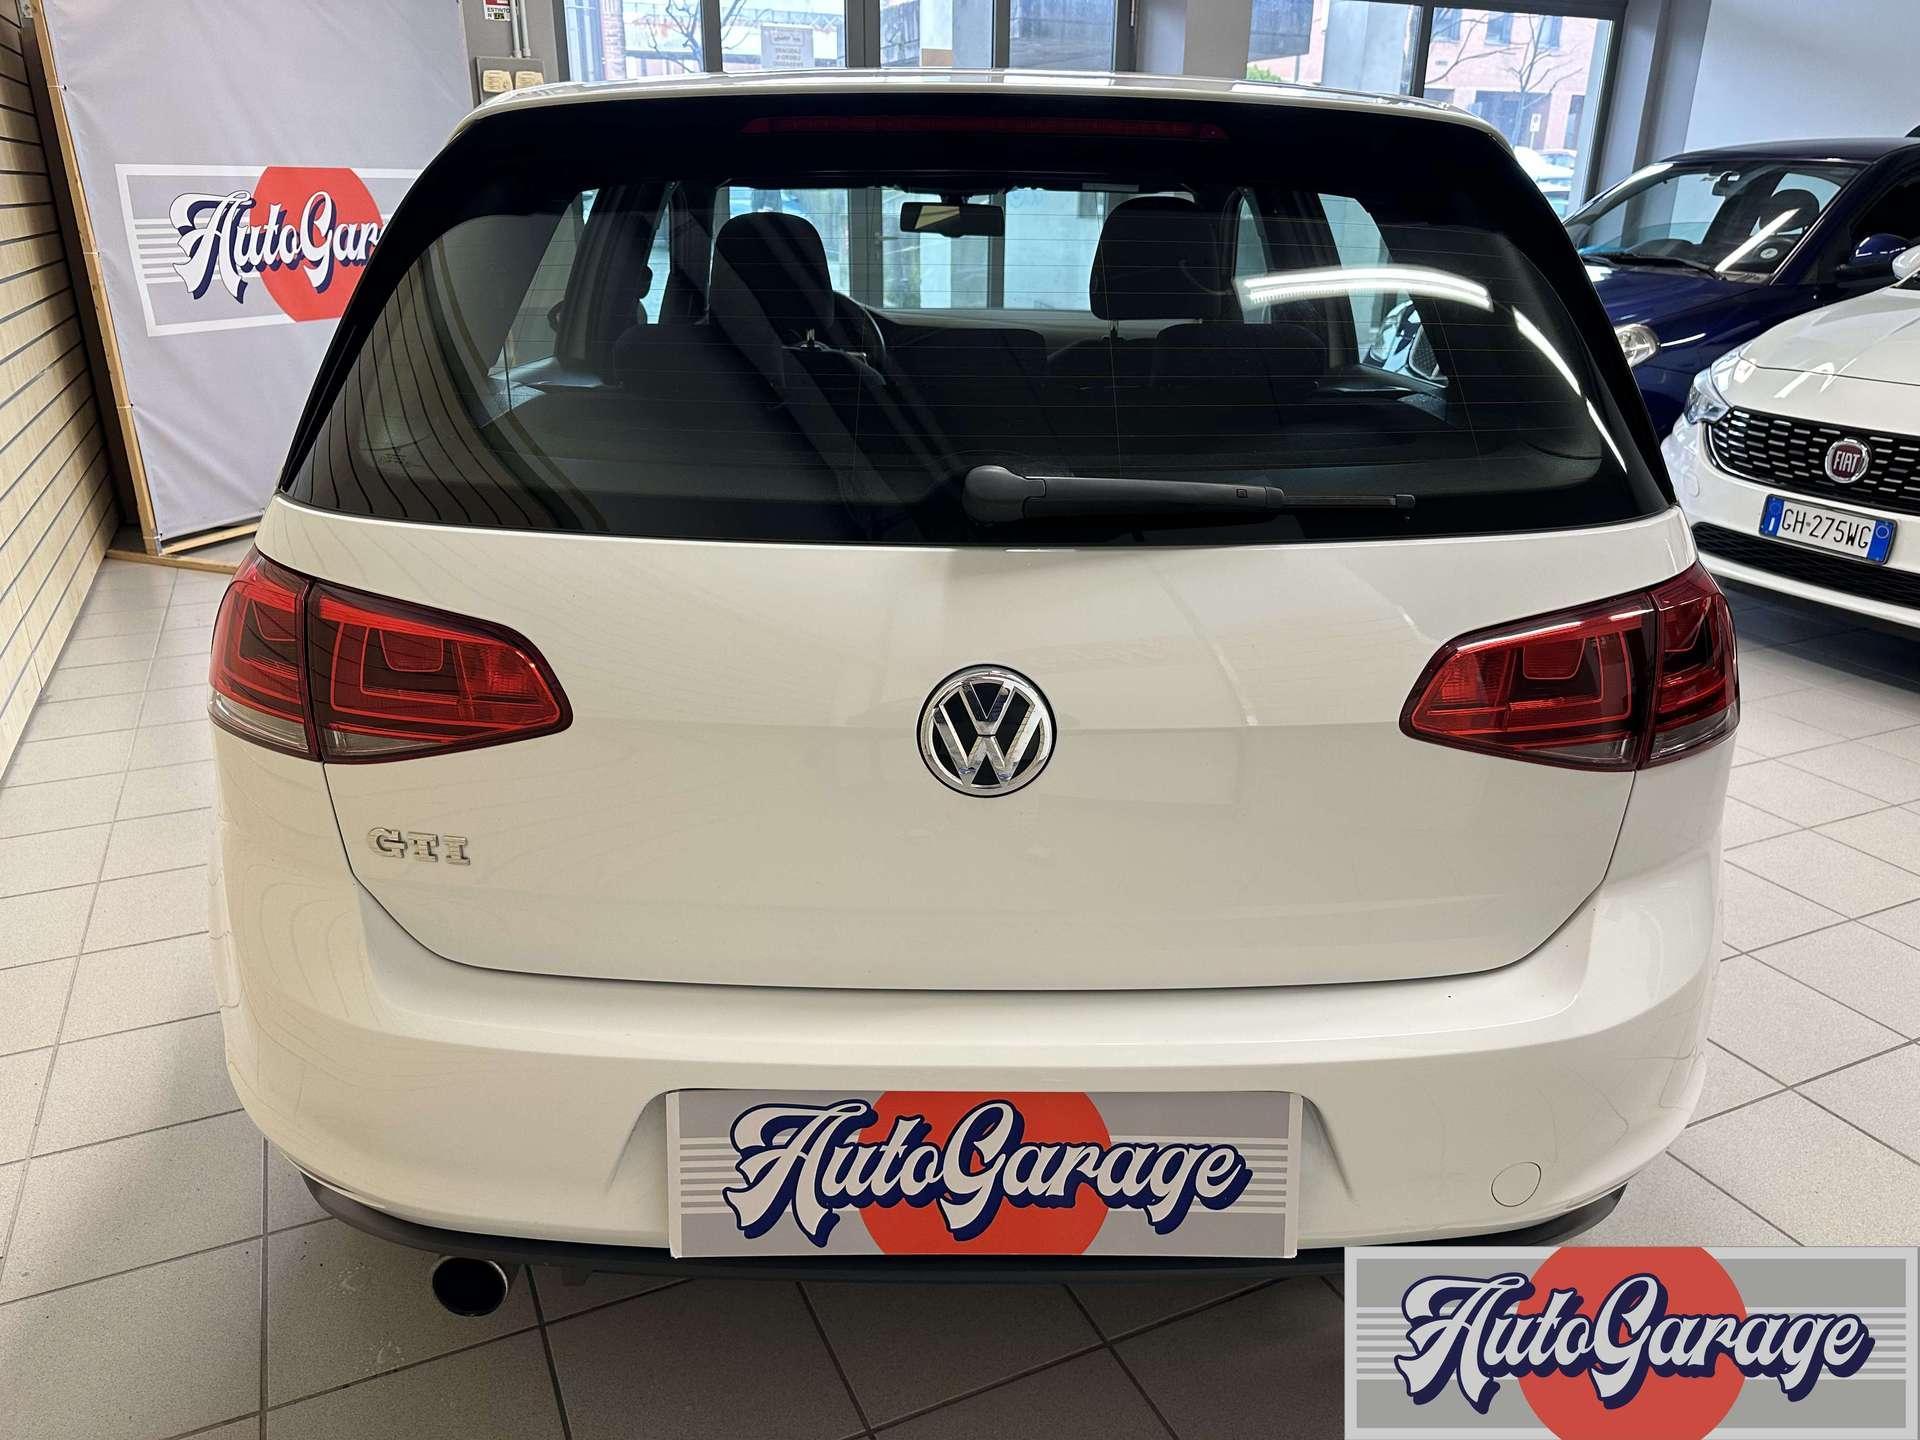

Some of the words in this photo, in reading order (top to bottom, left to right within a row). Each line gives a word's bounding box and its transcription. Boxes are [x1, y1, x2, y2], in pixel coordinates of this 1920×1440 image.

[169, 190, 384, 304] AutoGar
[1833, 451, 1860, 473] FIAT
[930, 676, 1044, 789] VW
[367, 827, 471, 866] GTI
[724, 1099, 1253, 1249] AutoGarage
